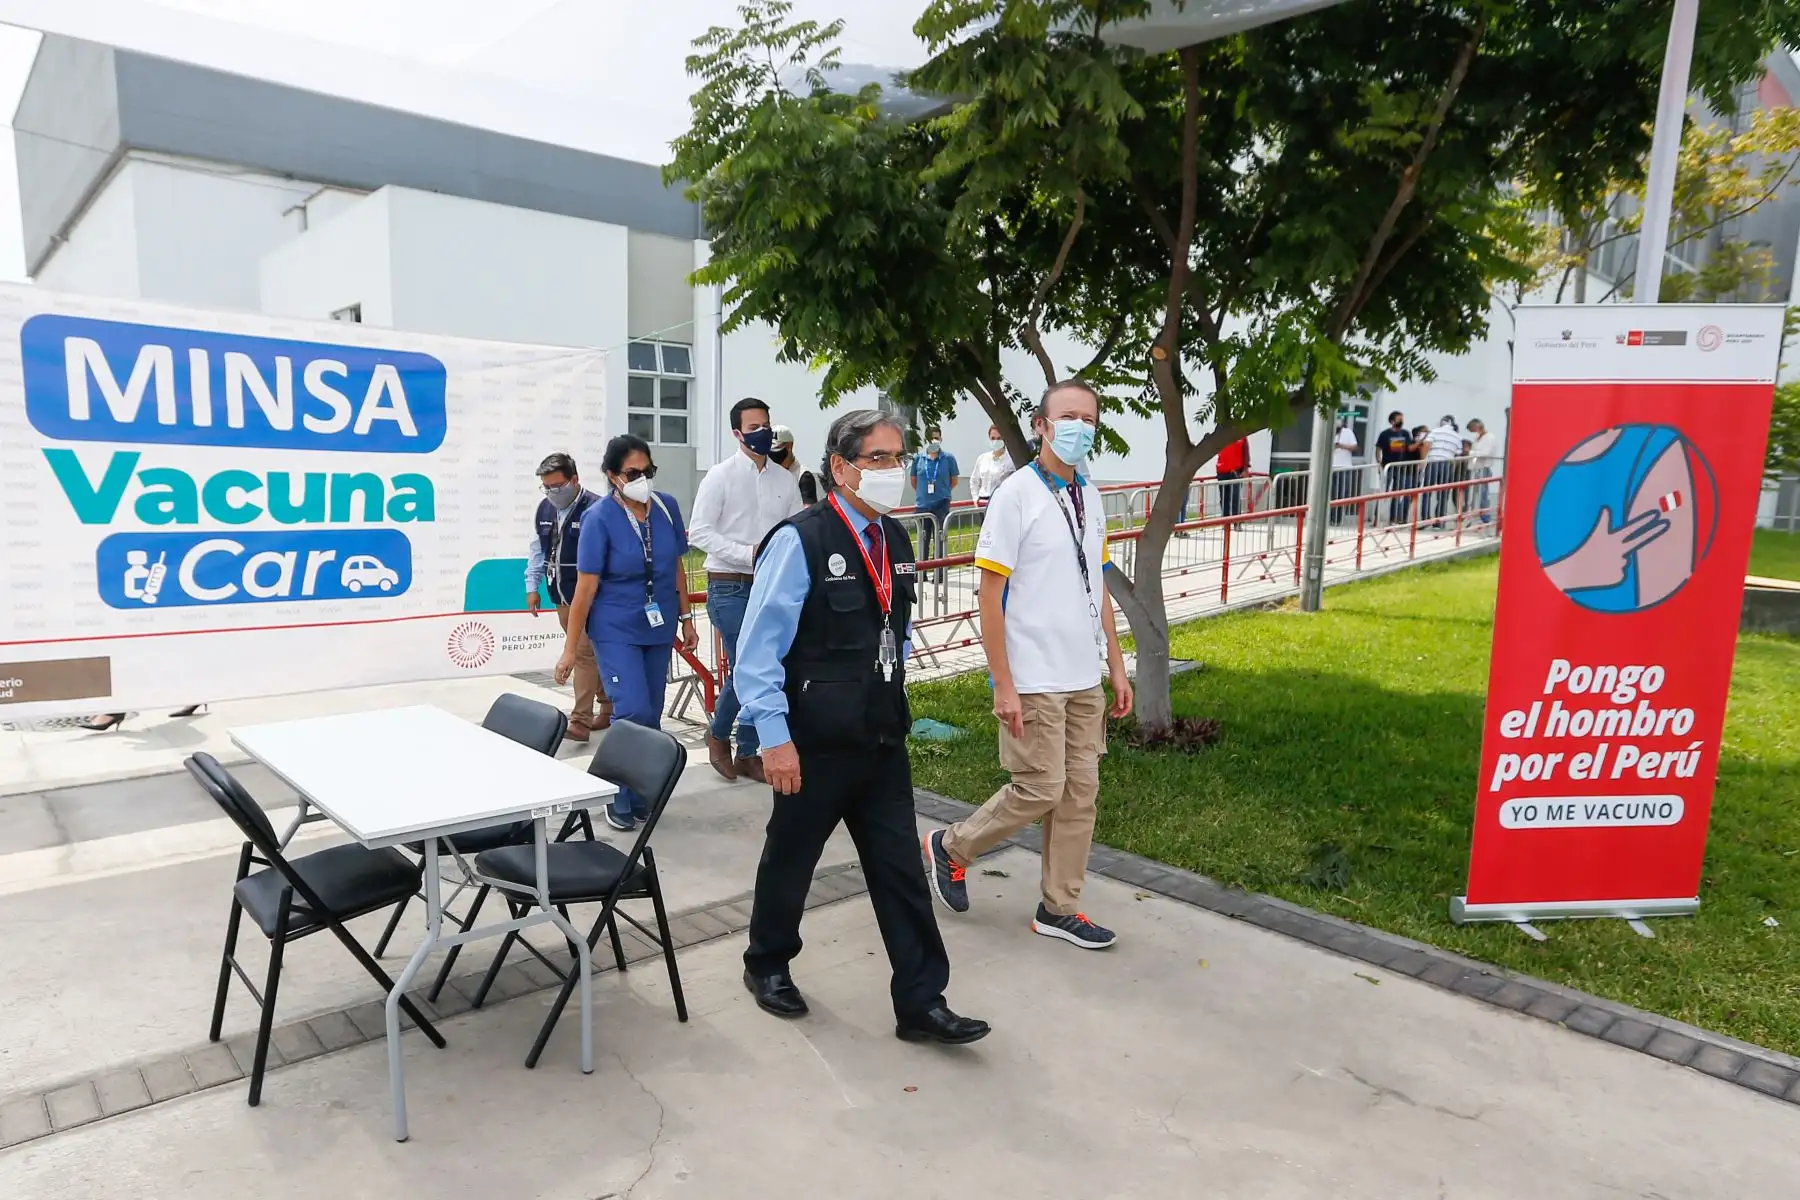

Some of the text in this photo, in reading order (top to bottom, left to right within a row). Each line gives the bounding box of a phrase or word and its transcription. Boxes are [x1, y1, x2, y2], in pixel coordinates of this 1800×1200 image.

[64, 336, 419, 437] MINSA
[42, 448, 435, 525] Vacuna
[178, 538, 336, 602] Car
[502, 632, 565, 643] BICENTENARIO
[1543, 658, 1665, 704] Pongo
[1499, 699, 1695, 739] el hombro
[1489, 740, 1705, 793] por el Perú
[1511, 802, 1674, 822] YO ME VACUNO
